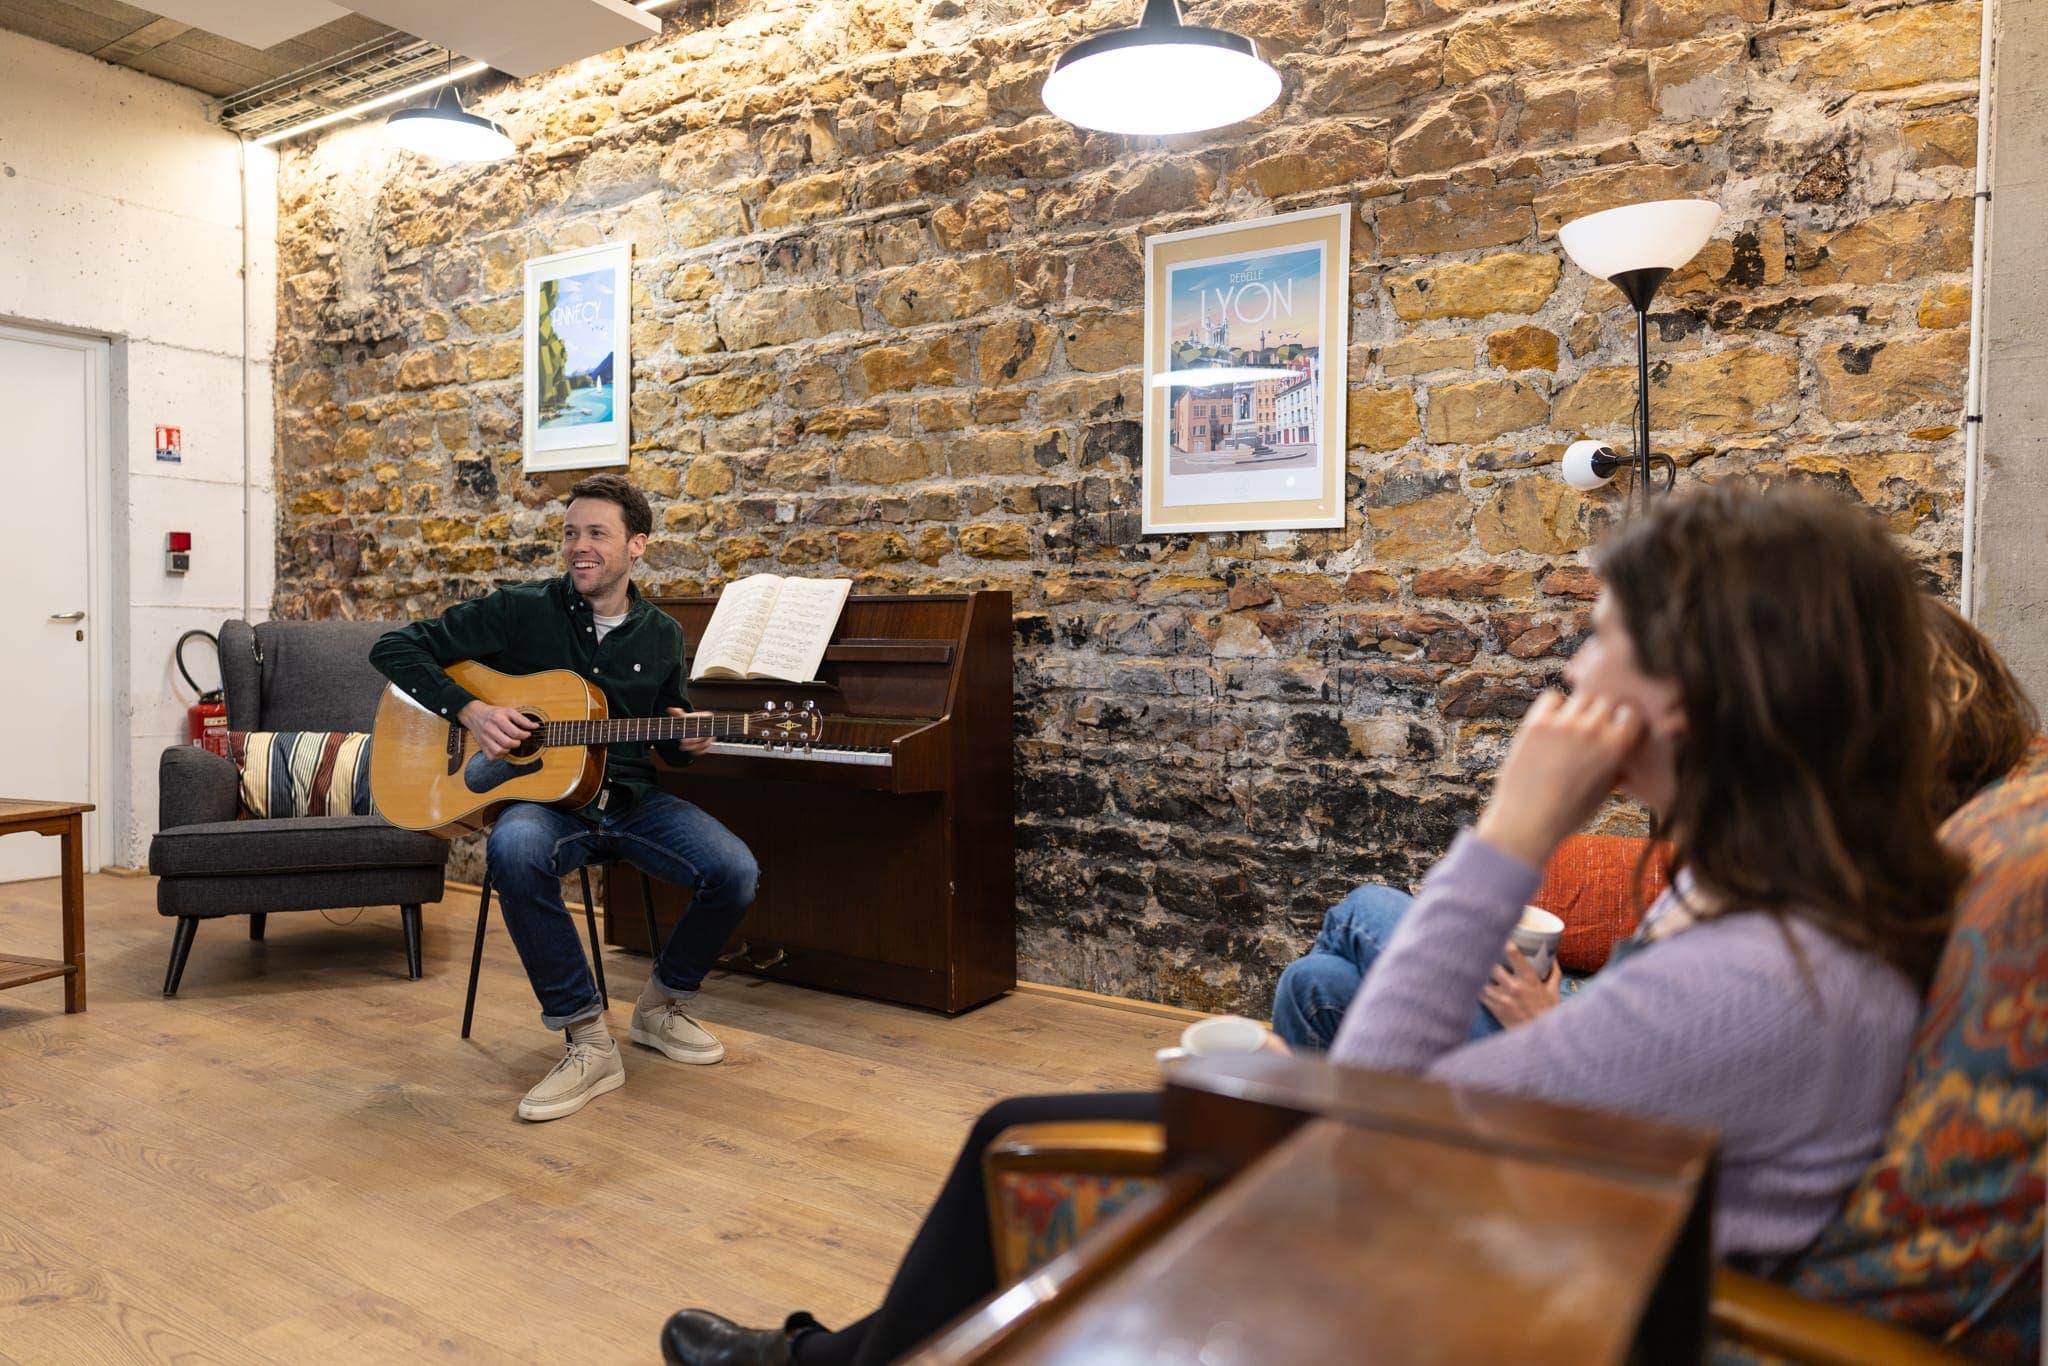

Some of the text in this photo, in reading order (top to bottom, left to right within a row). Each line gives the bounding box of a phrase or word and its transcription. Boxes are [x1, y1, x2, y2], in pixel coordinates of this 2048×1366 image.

[1230, 270, 1264, 284] REBELLE
[553, 300, 601, 327] ANNECY
[1201, 278, 1292, 331] LYON
